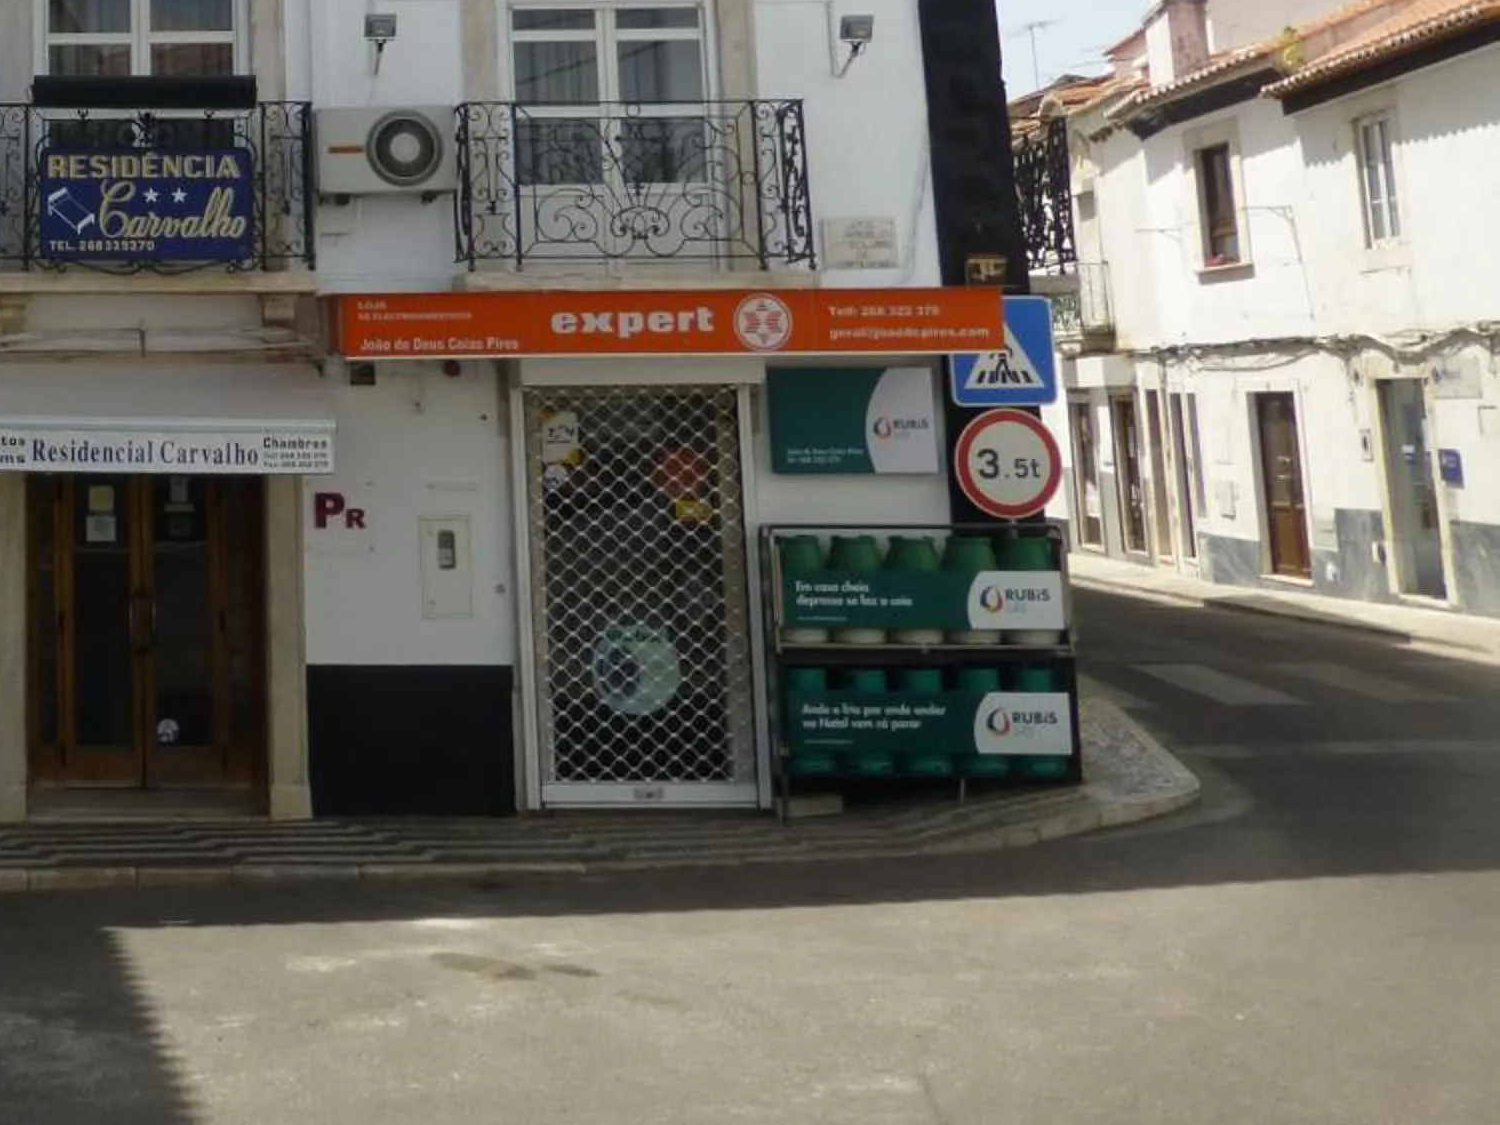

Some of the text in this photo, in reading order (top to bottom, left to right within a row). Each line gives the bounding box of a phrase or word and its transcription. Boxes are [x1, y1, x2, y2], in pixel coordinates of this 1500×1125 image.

[48, 151, 241, 179] RESIDÊNCIA
[99, 179, 246, 239] Carvalho
[551, 306, 714, 339] expert
[360, 336, 391, 351] João
[394, 337, 410, 350] de
[413, 337, 445, 350] Deus
[31, 438, 259, 465] Residencial Carvalho
[262, 436, 328, 449] Chambres
